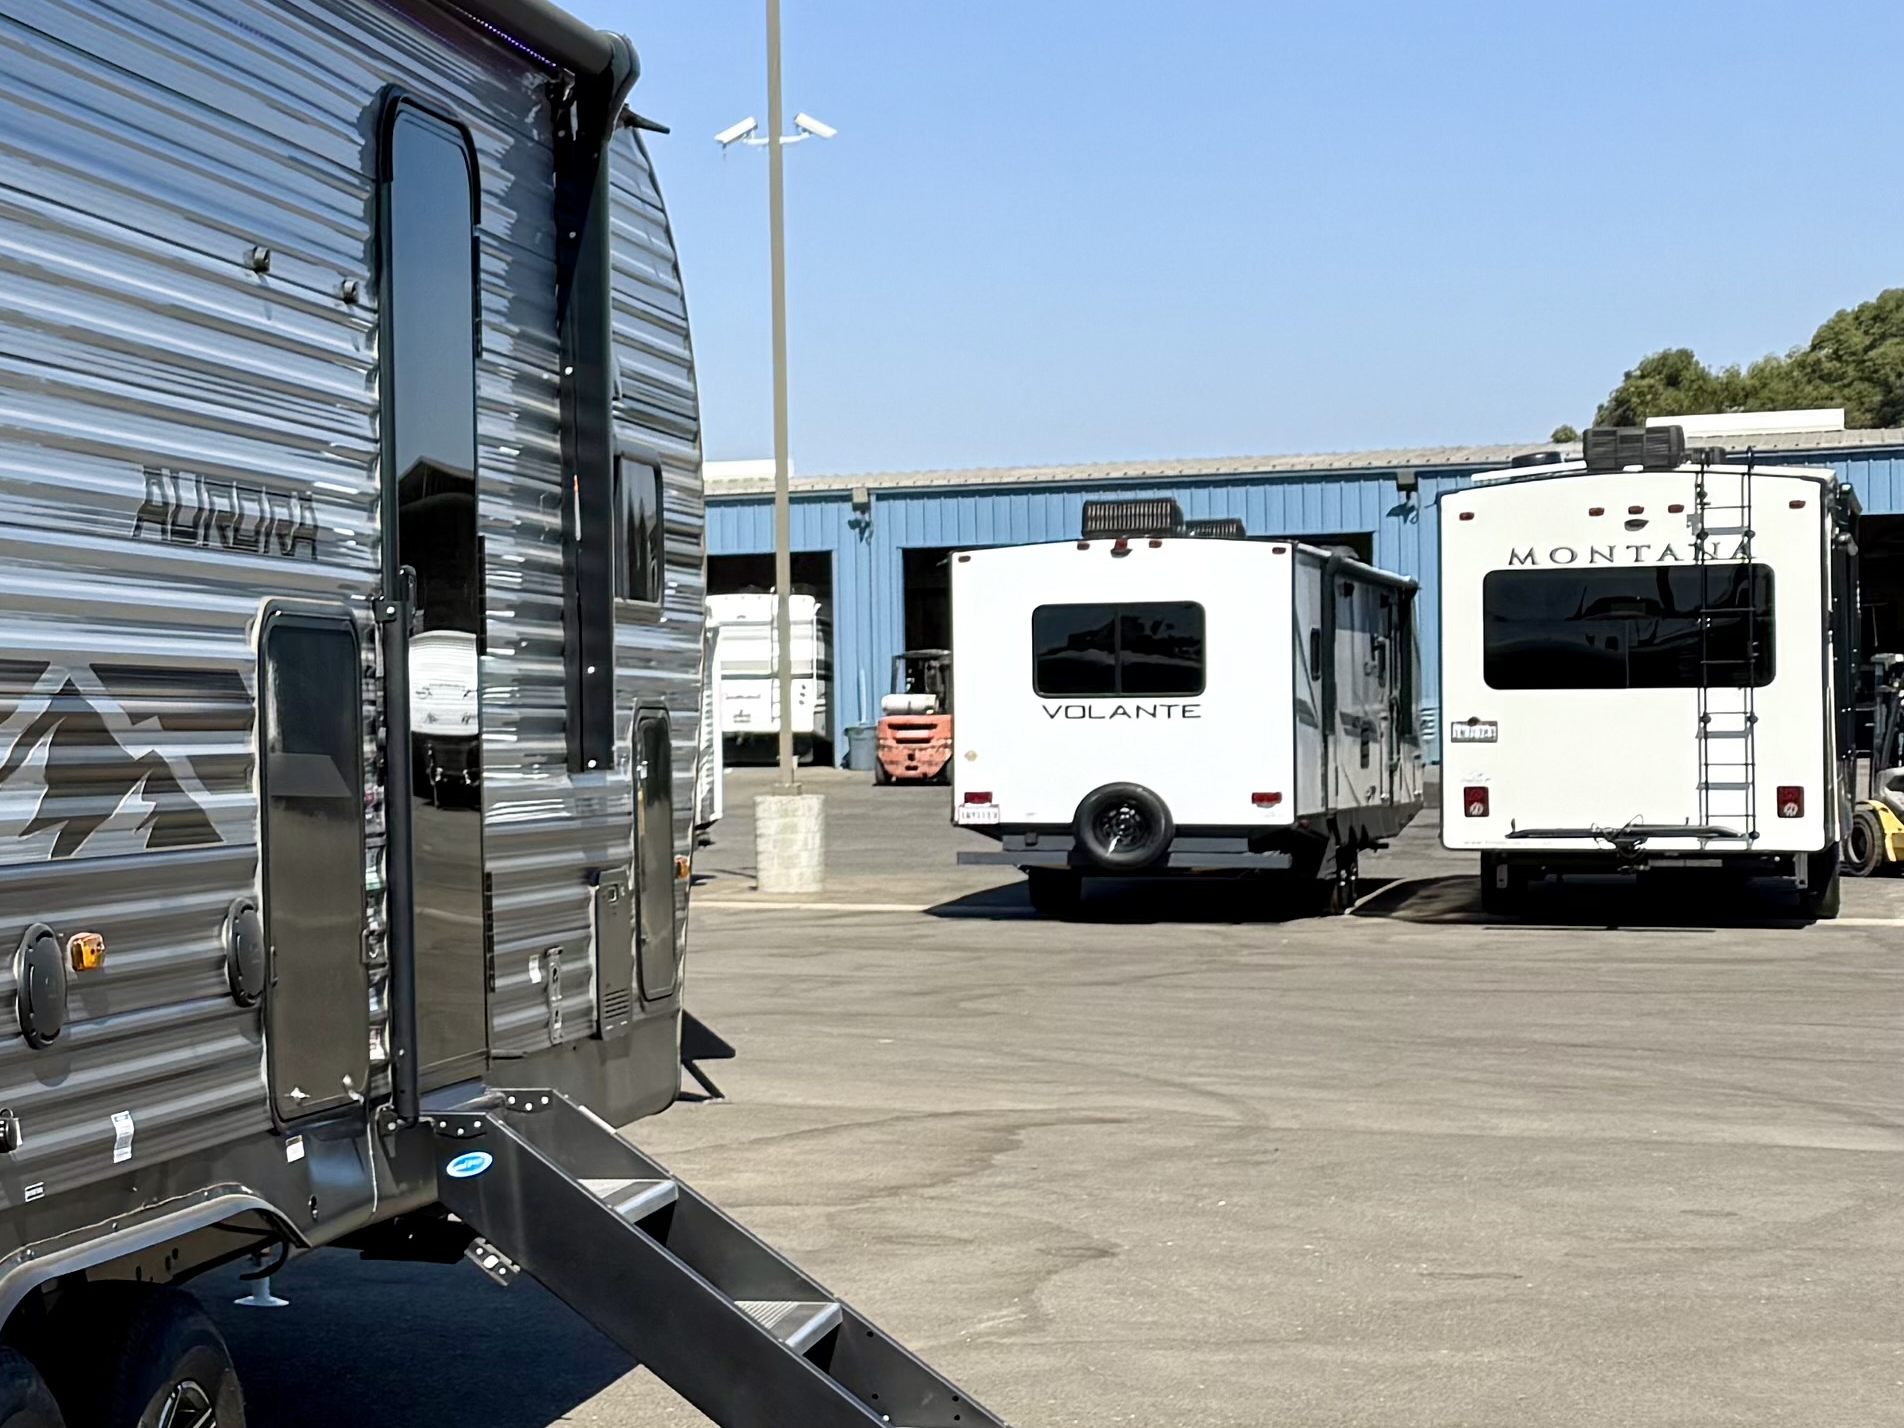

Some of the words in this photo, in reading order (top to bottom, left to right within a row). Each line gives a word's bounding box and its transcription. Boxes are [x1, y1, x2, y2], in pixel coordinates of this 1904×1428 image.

[130, 467, 319, 561] AURORA
[1508, 541, 1757, 567] MONTANA
[1041, 703, 1202, 720] VOLANTE
